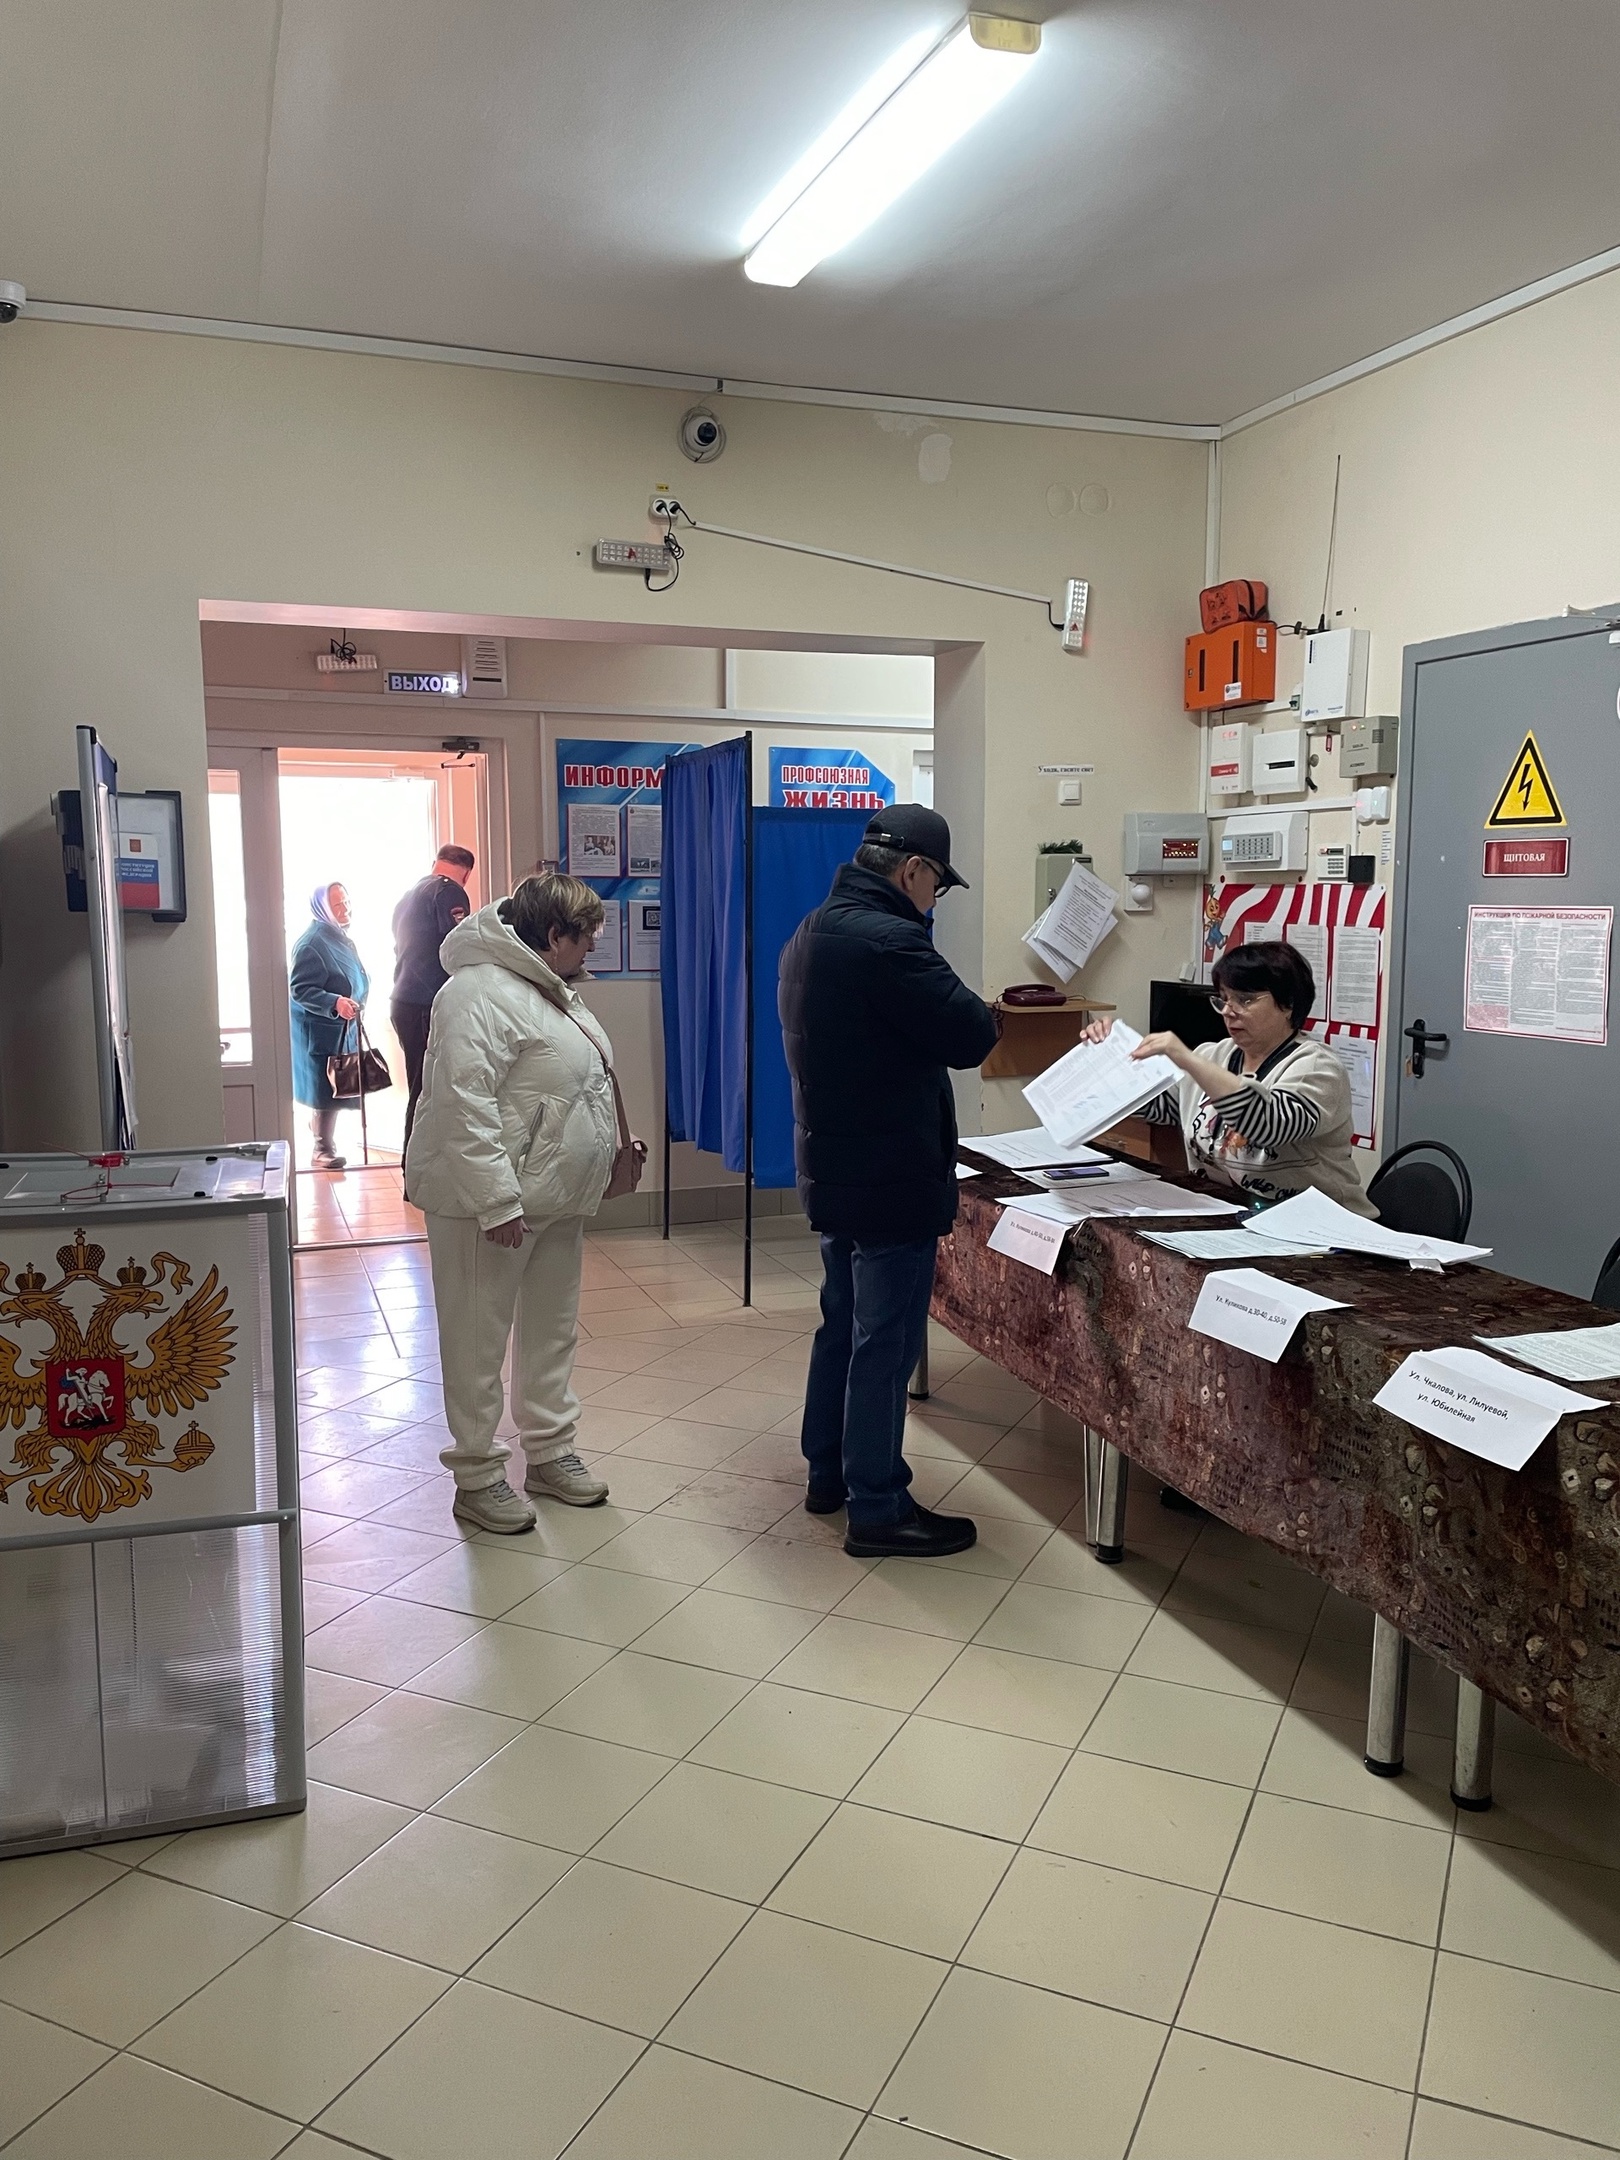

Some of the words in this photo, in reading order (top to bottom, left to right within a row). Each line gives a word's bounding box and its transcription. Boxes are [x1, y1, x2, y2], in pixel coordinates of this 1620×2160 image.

[391, 675, 458, 693] ВЫХОД
[781, 765, 870, 786] ПРОФСОЮЗНАЯ
[782, 789, 886, 809] ЖИЗНЬ
[1504, 853, 1546, 862] ЩИТОВАЯ
[1474, 911, 1511, 919] ИНСТРУКЦИЯ
[1522, 911, 1555, 920] ПОЖАРНОЙ
[1556, 912, 1606, 920] БЕЗОПАСНОСТИ
[1215, 1295, 1223, 1303] Ул.
[1224, 1298, 1248, 1312] Куликова
[1408, 1370, 1421, 1382] Ул.
[1423, 1376, 1455, 1397] Чкалова,
[1456, 1392, 1468, 1402] ул.
[1417, 1393, 1429, 1403] ул.
[1431, 1398, 1476, 1423] Юбилейная
